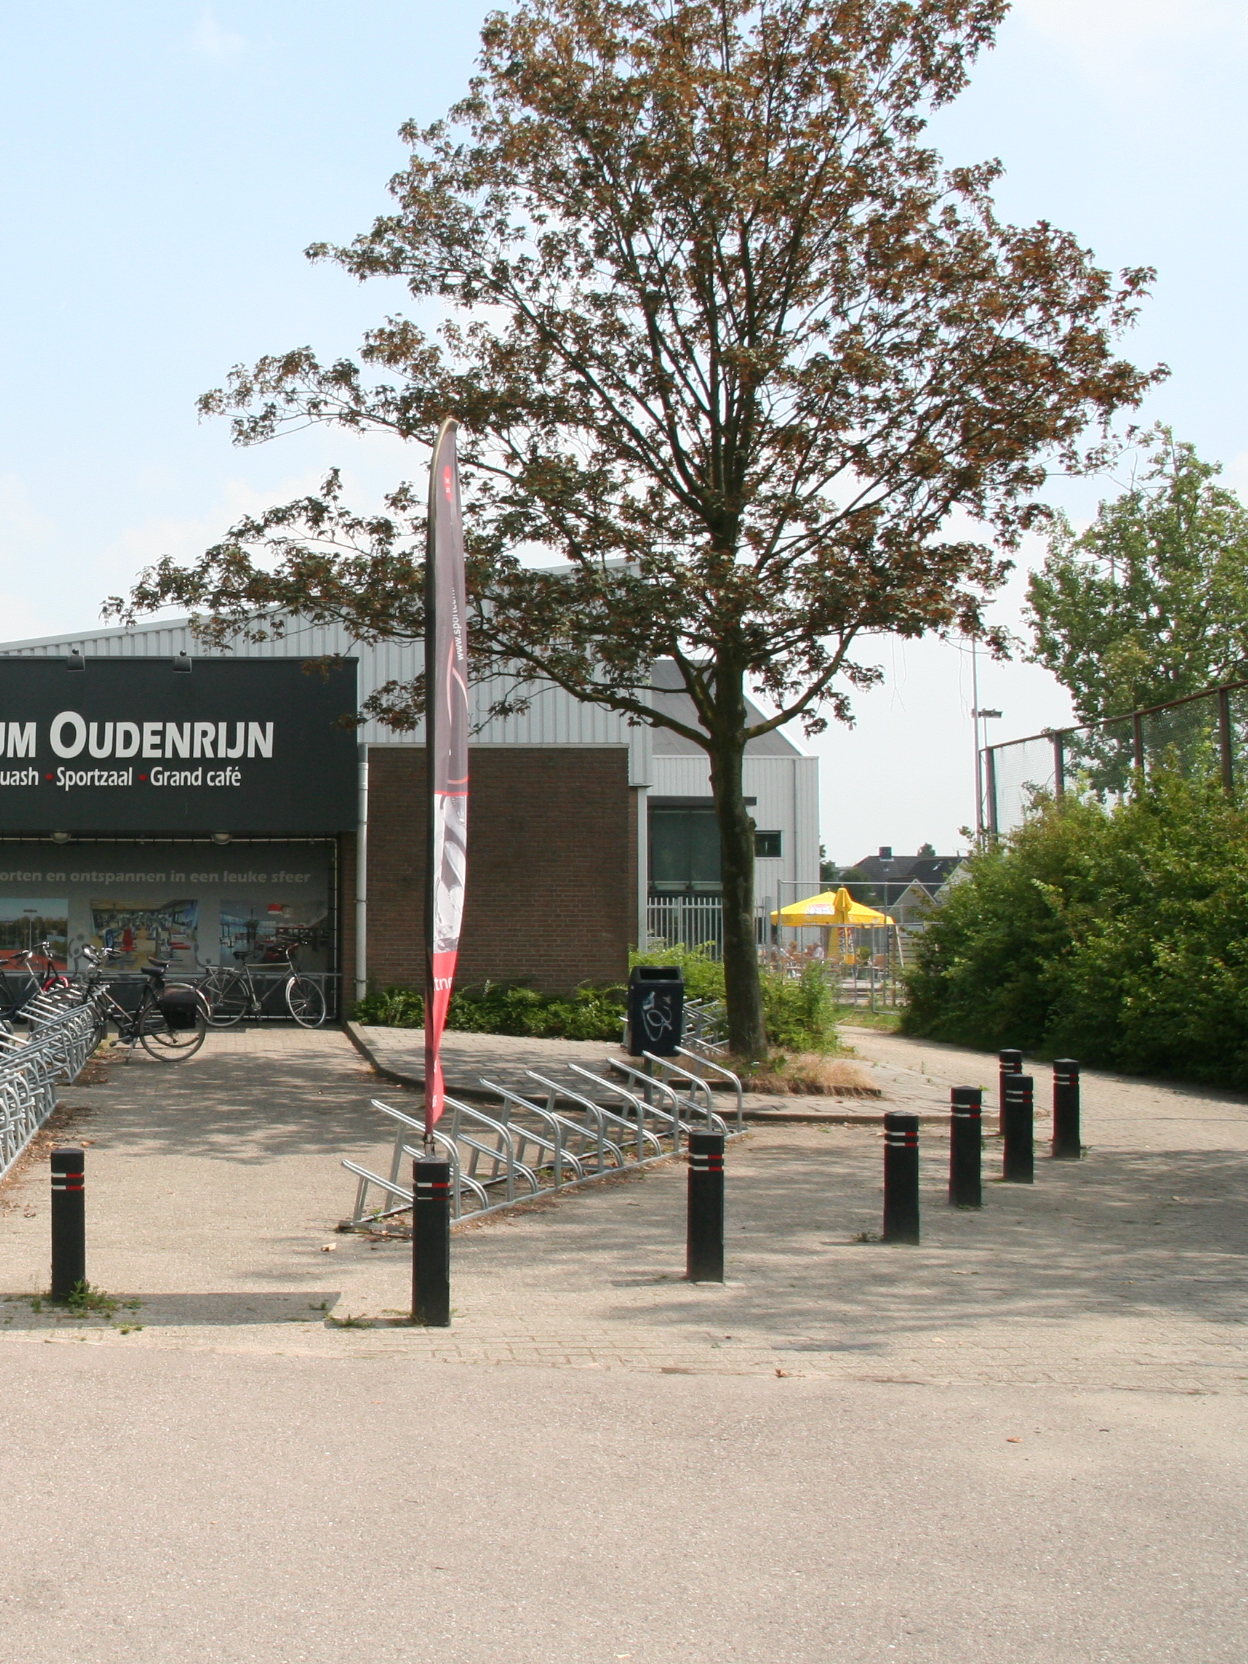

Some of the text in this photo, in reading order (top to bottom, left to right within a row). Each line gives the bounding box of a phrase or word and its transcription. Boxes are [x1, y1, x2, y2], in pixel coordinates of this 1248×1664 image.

[49, 710, 274, 759] OUDENRIJN
[55, 766, 133, 792] Sportzaal
[150, 766, 203, 787] Grand
[206, 766, 242, 787] café
[46, 871, 66, 882] en
[69, 870, 166, 885] ontspannen
[170, 870, 186, 882] in
[189, 871, 219, 883] een
[223, 870, 268, 883] leuke
[270, 870, 311, 883] sfeer
